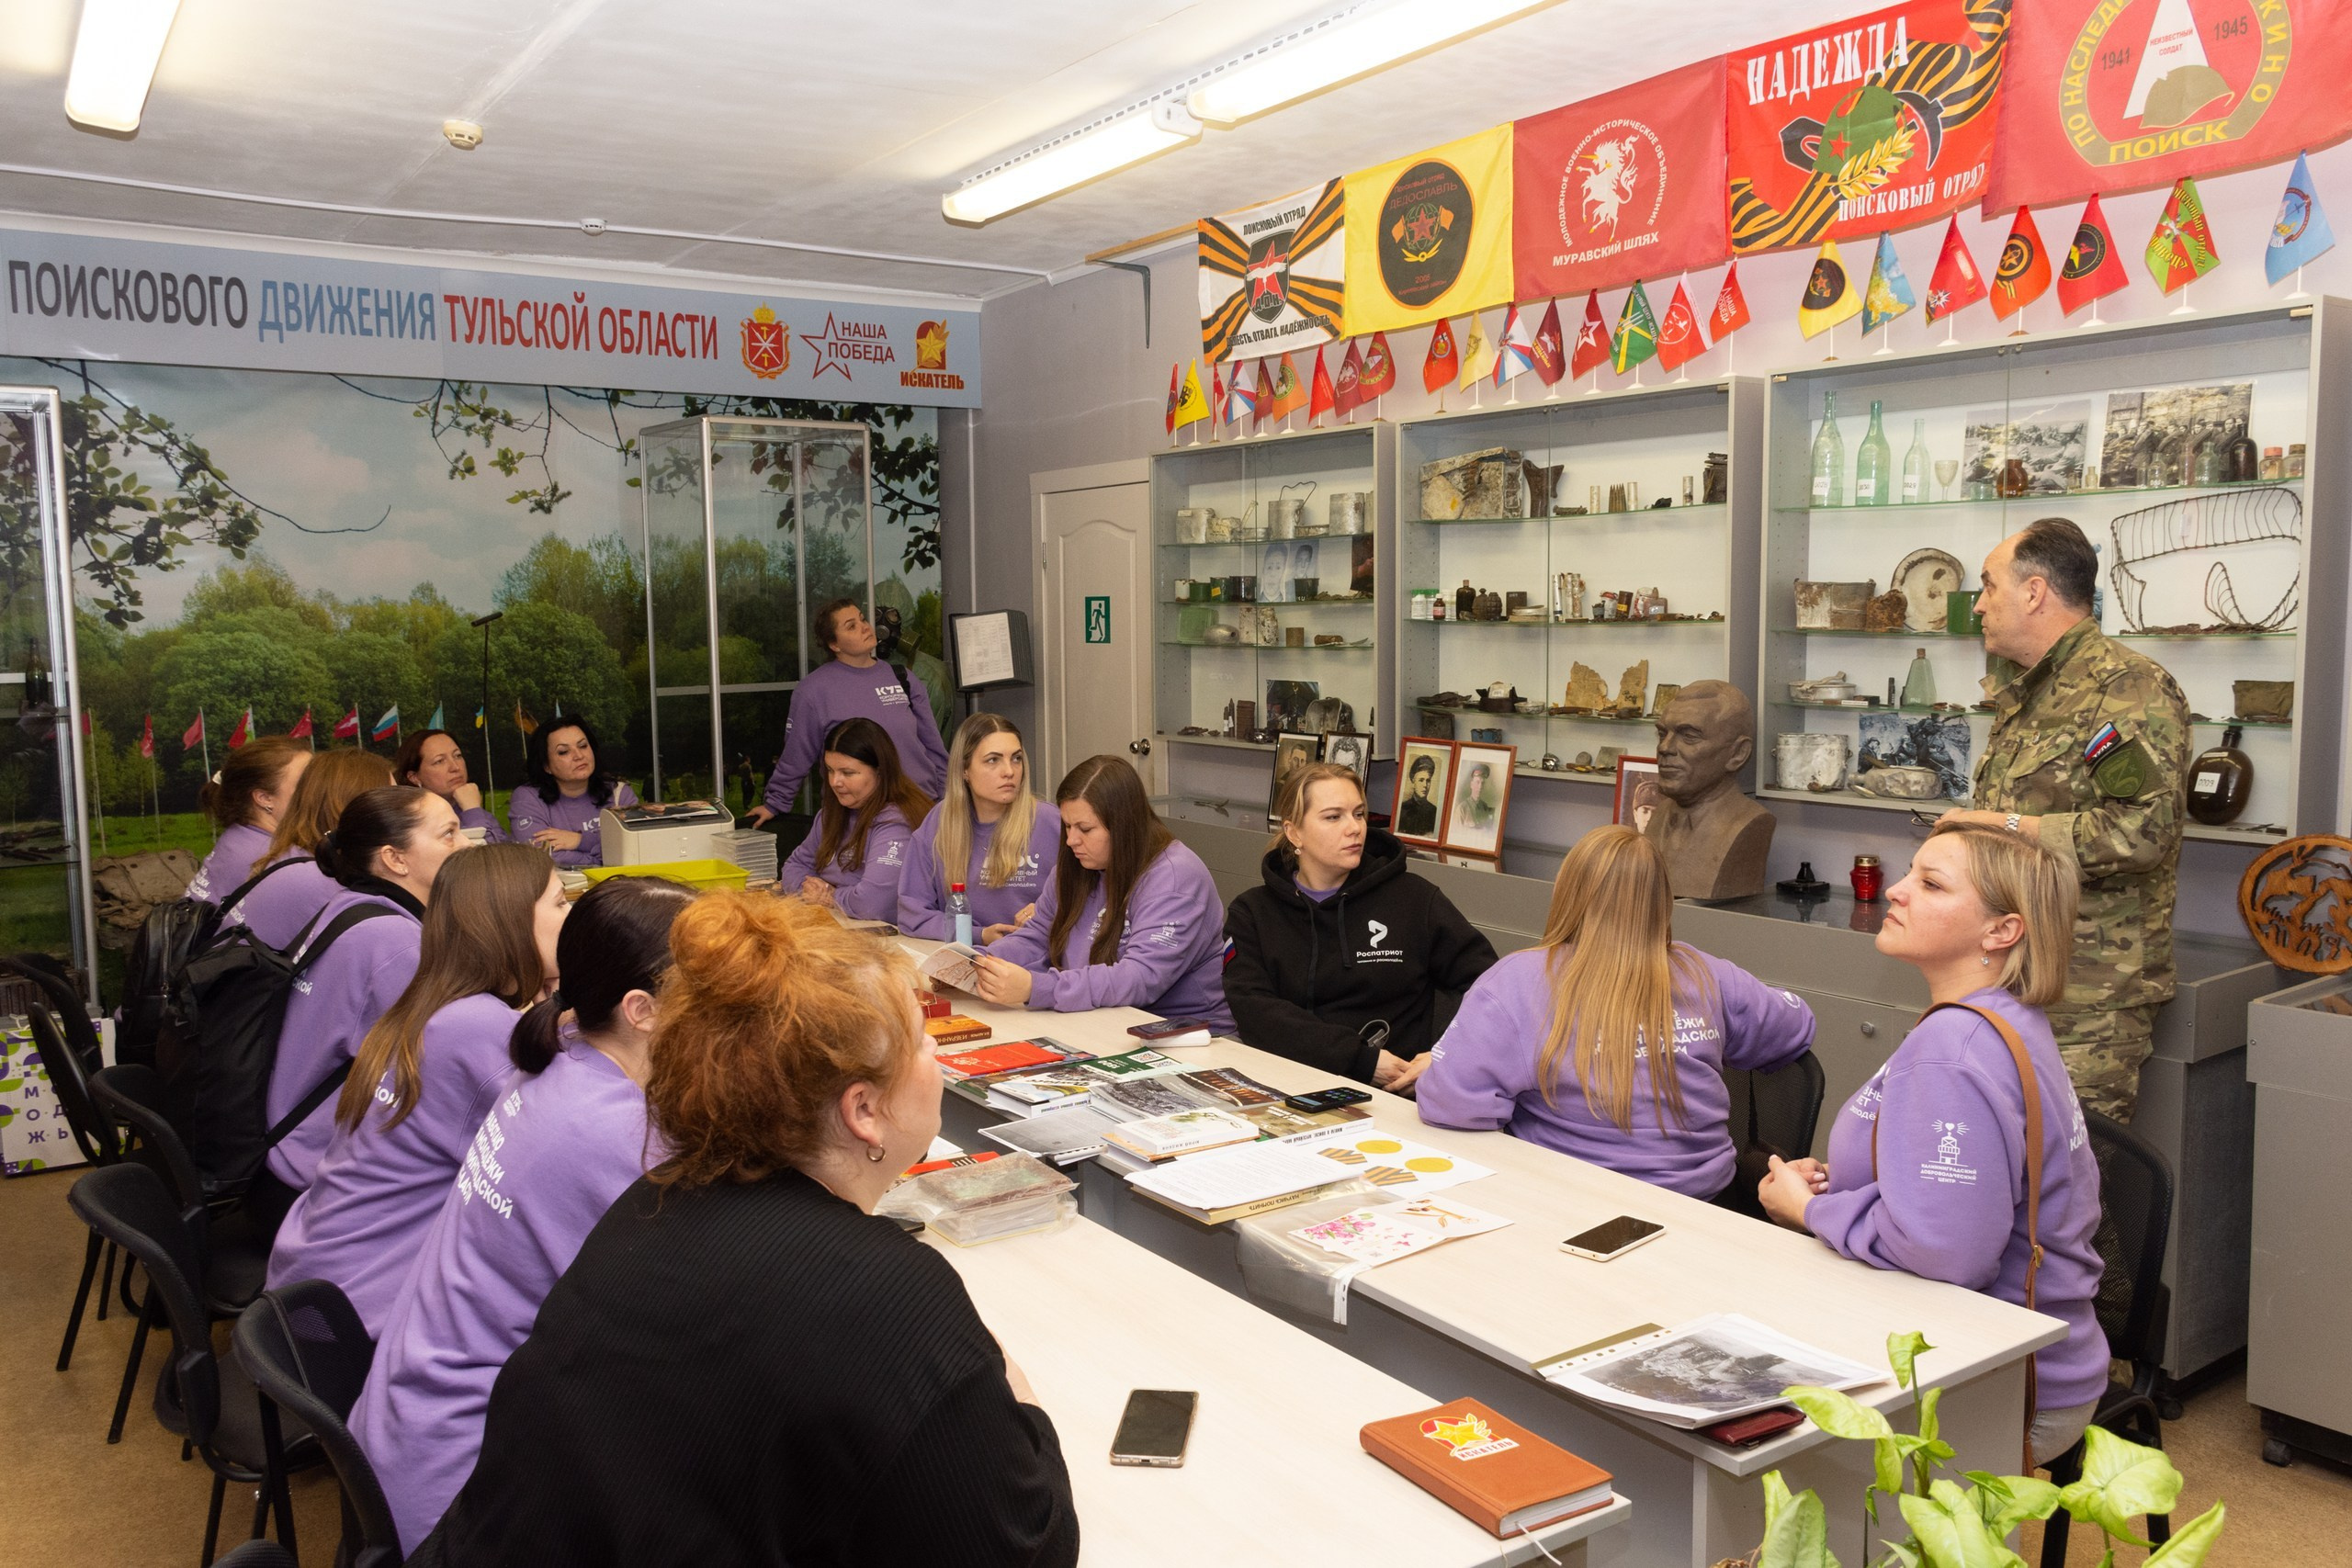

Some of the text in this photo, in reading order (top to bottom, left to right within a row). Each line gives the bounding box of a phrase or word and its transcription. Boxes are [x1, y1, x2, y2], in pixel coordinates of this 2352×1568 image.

[2150, 27, 2194, 46] НЕИЗВЕСТНЫЙ
[2213, 16, 2248, 41] 1945
[1747, 16, 1909, 106] НАДЕЖДА
[2101, 47, 2131, 72] 1941
[2159, 43, 2183, 57] СОЛДАТ
[2109, 119, 2230, 164] ПОИСК
[1565, 118, 1658, 174] ВОЕННО-ИСТОРИЧЕСКОЕ
[1646, 144, 1668, 226] ОБЪЕДИНЕНИЕ
[1388, 182, 1458, 210] ДЕДОСЛАВЛЬ
[1838, 176, 1936, 222] ПОИСКОВЫЙ
[1243, 206, 1306, 236] ПОИСКОВЫЙ ОТРЯД
[1552, 231, 1659, 266] МУРАВСКИЙ ШЛЯХ
[8, 260, 718, 360] ПОИСКОВОГО ДВИЖЕНИЯ ТУЛЬСКОЙ ОБЛАСТИ
[1724, 293, 1738, 318] НАША
[842, 321, 888, 341] НАША
[828, 342, 896, 364] ПОБЕДА
[900, 371, 965, 390] ИСКАТЕЛЬ
[1920, 1169, 1977, 1181] ДОБРОВОЛЬЧЕСКИЙ
[1921, 1163, 1977, 1175] КАЛИНИНГРАДСКИЙ
[1249, 1193, 1300, 1211] НАУЧИСЬ ПОМНИТЬ
[1458, 1440, 1514, 1459] ИСКАТЕЛЬ
